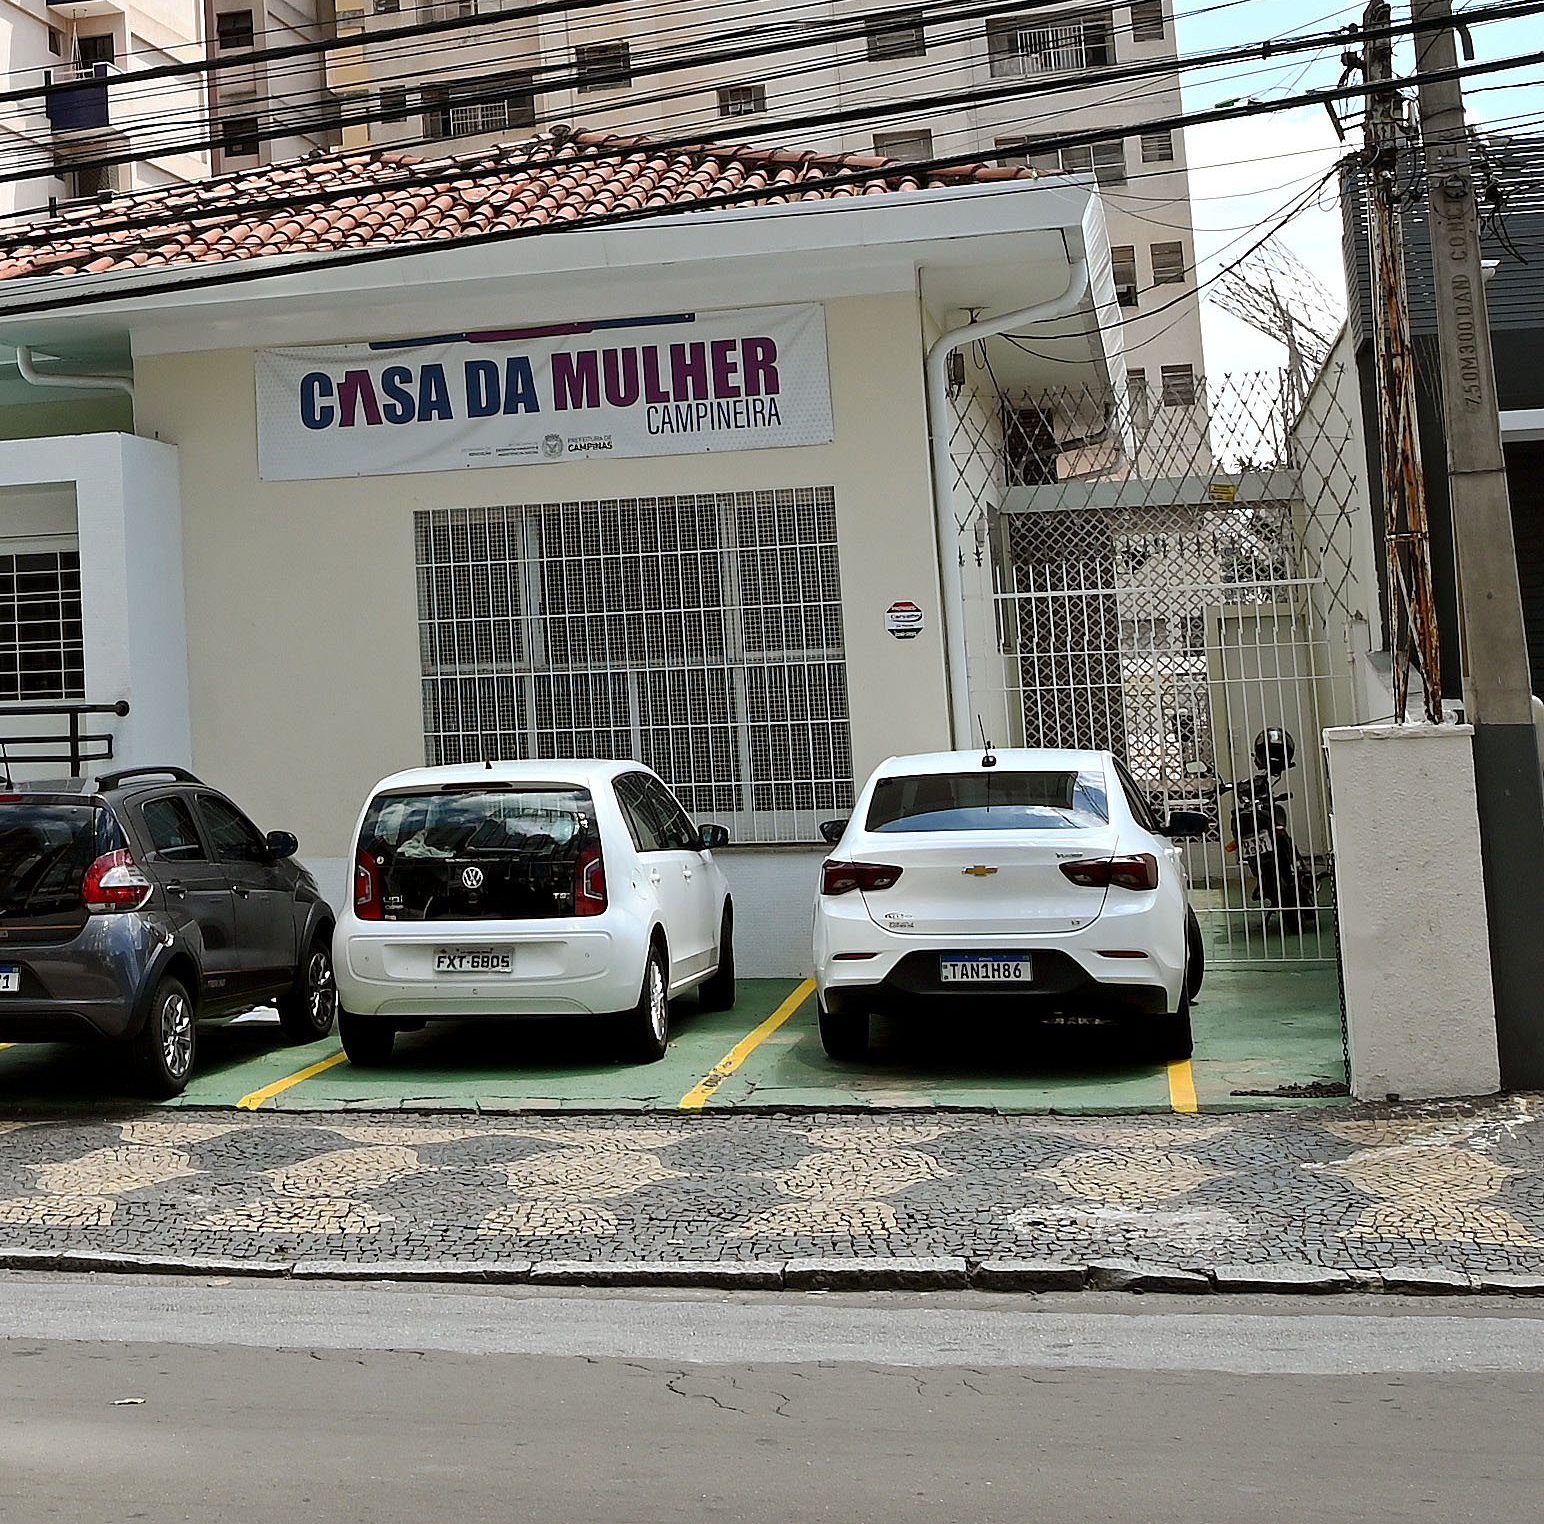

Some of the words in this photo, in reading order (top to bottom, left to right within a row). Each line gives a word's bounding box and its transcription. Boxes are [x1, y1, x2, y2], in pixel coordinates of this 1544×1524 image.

[300, 365, 453, 430] CASA
[464, 356, 540, 418] DA
[551, 337, 780, 411] MULHER
[646, 397, 782, 435] CAMPINEIRA
[949, 962, 1023, 979] TAN1H86
